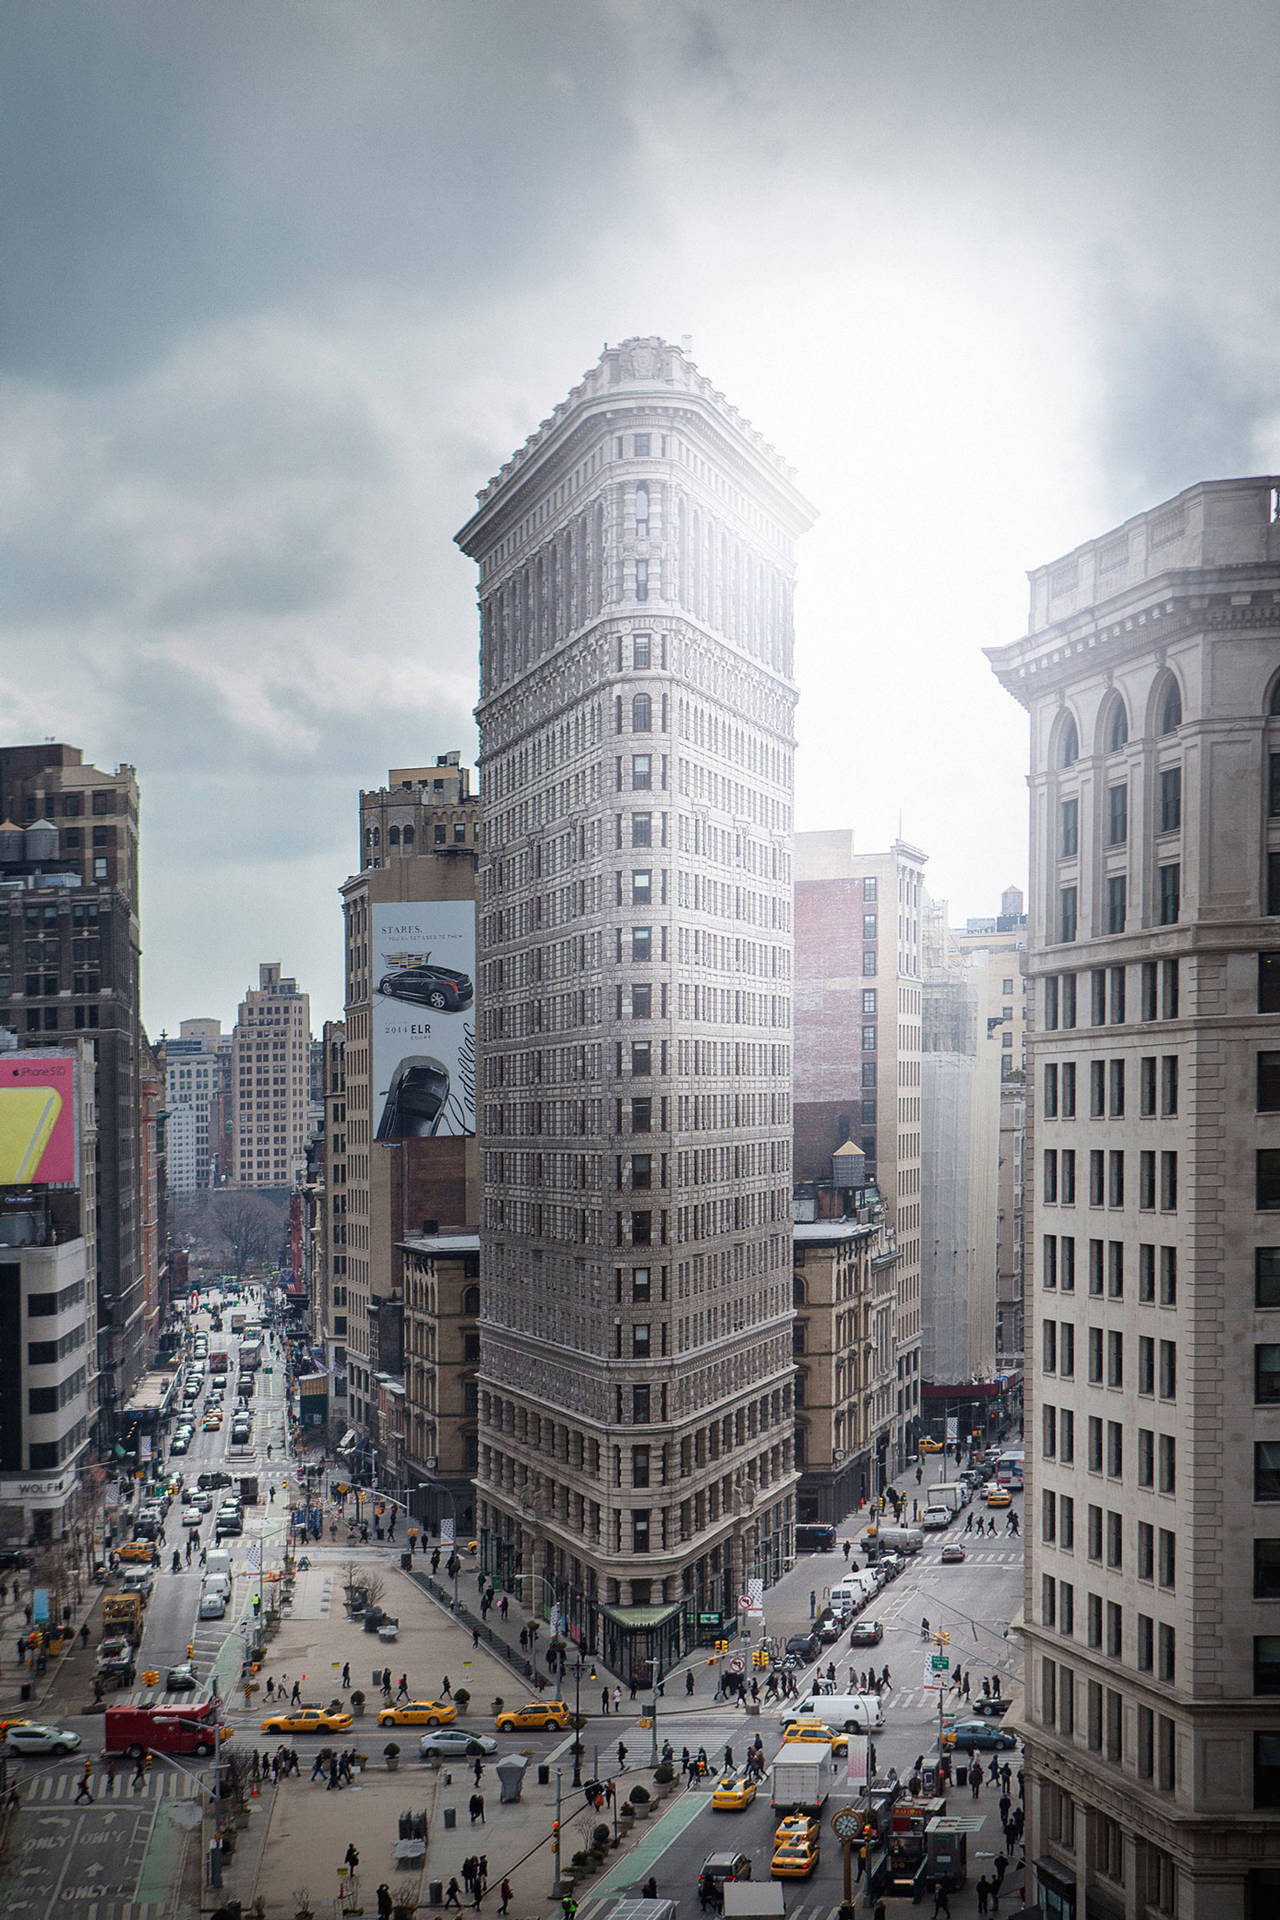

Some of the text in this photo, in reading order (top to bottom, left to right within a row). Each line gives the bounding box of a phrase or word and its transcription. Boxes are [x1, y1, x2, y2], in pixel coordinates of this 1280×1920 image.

[410, 1024, 431, 1034] ELR
[440, 1022, 476, 1136] Cadillac
[61, 1883, 111, 1901] ONLY
